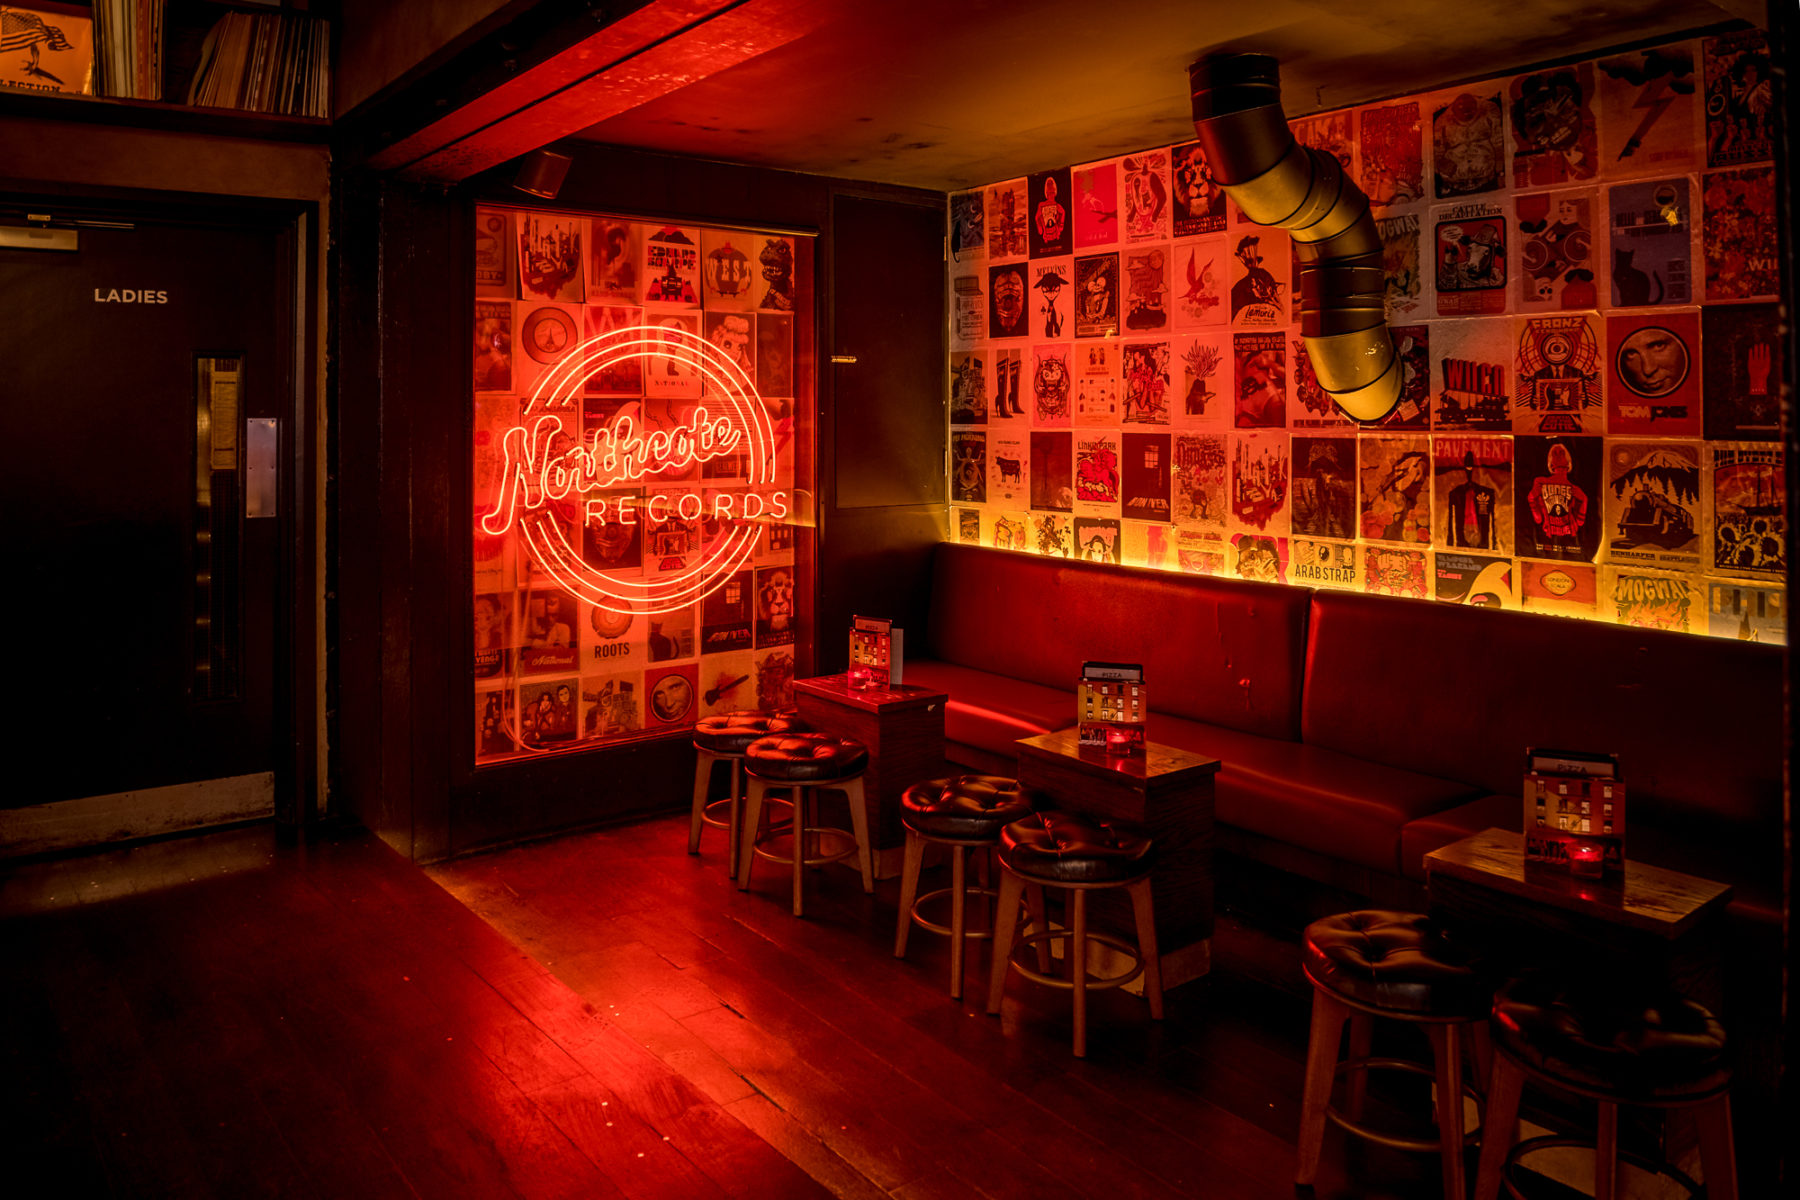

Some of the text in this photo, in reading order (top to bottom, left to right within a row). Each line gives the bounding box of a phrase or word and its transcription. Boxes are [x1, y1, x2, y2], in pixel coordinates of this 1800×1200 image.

[706, 258, 753, 284] WEST
[94, 288, 169, 304] LADIES
[1441, 358, 1505, 397] WILCO
[1618, 405, 1651, 419] TOM
[1435, 439, 1511, 460] PAVEMENT
[481, 407, 742, 534] Northcote
[584, 492, 788, 527] RECORDS
[1295, 564, 1356, 583] ARAB STRAP
[1616, 577, 1690, 602] MOGWAI
[594, 642, 630, 658] ROOTS
[1102, 671, 1122, 679] PIZZA
[1557, 763, 1588, 775] PIZZA
